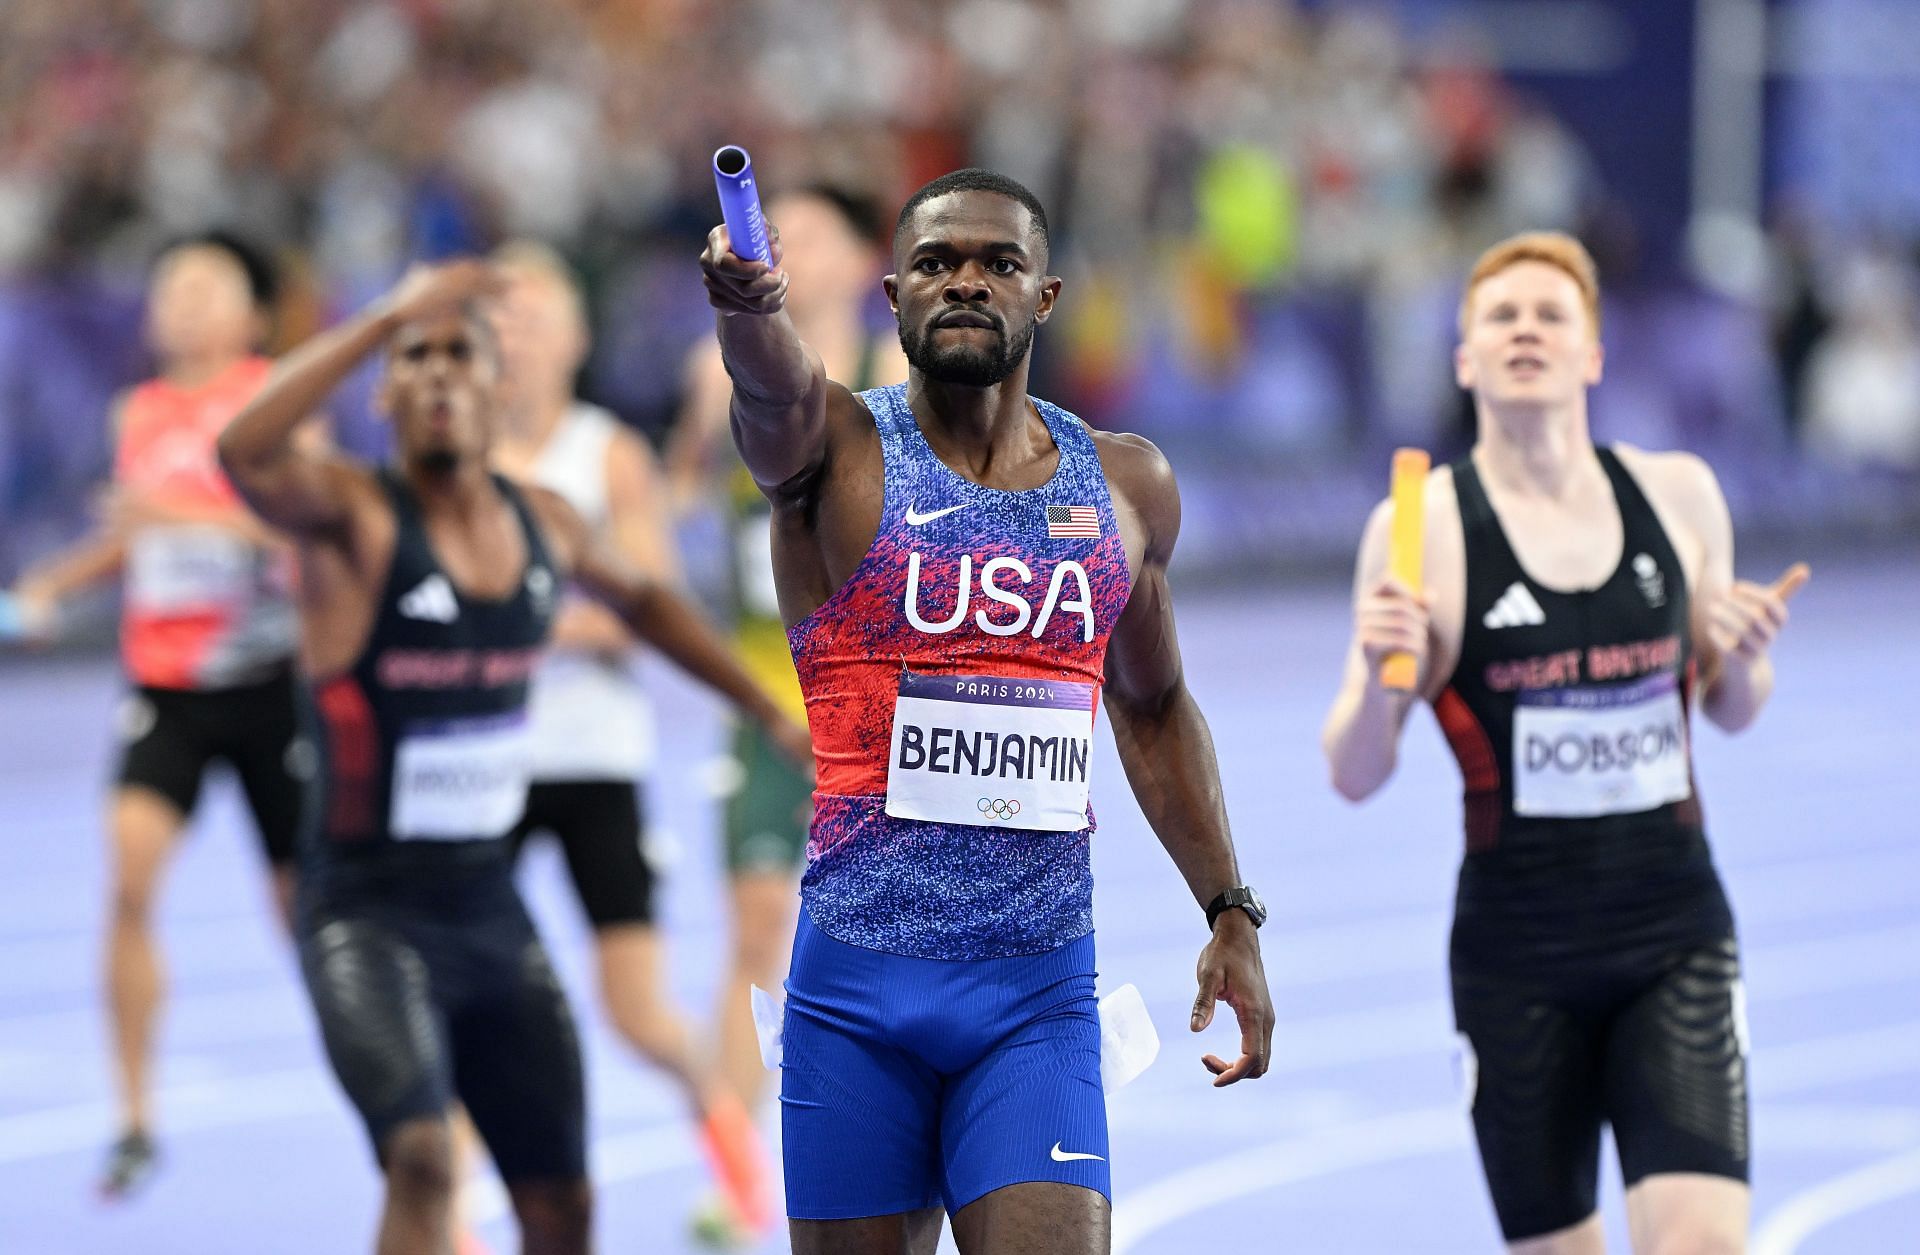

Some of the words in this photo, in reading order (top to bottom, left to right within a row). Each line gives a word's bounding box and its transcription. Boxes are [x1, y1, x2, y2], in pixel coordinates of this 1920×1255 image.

[746, 201, 763, 242] PARIS
[904, 551, 1095, 643] USA
[956, 682, 1008, 697] PARIS
[1015, 686, 1054, 701] 2024
[899, 724, 1088, 783] BENJAMIN
